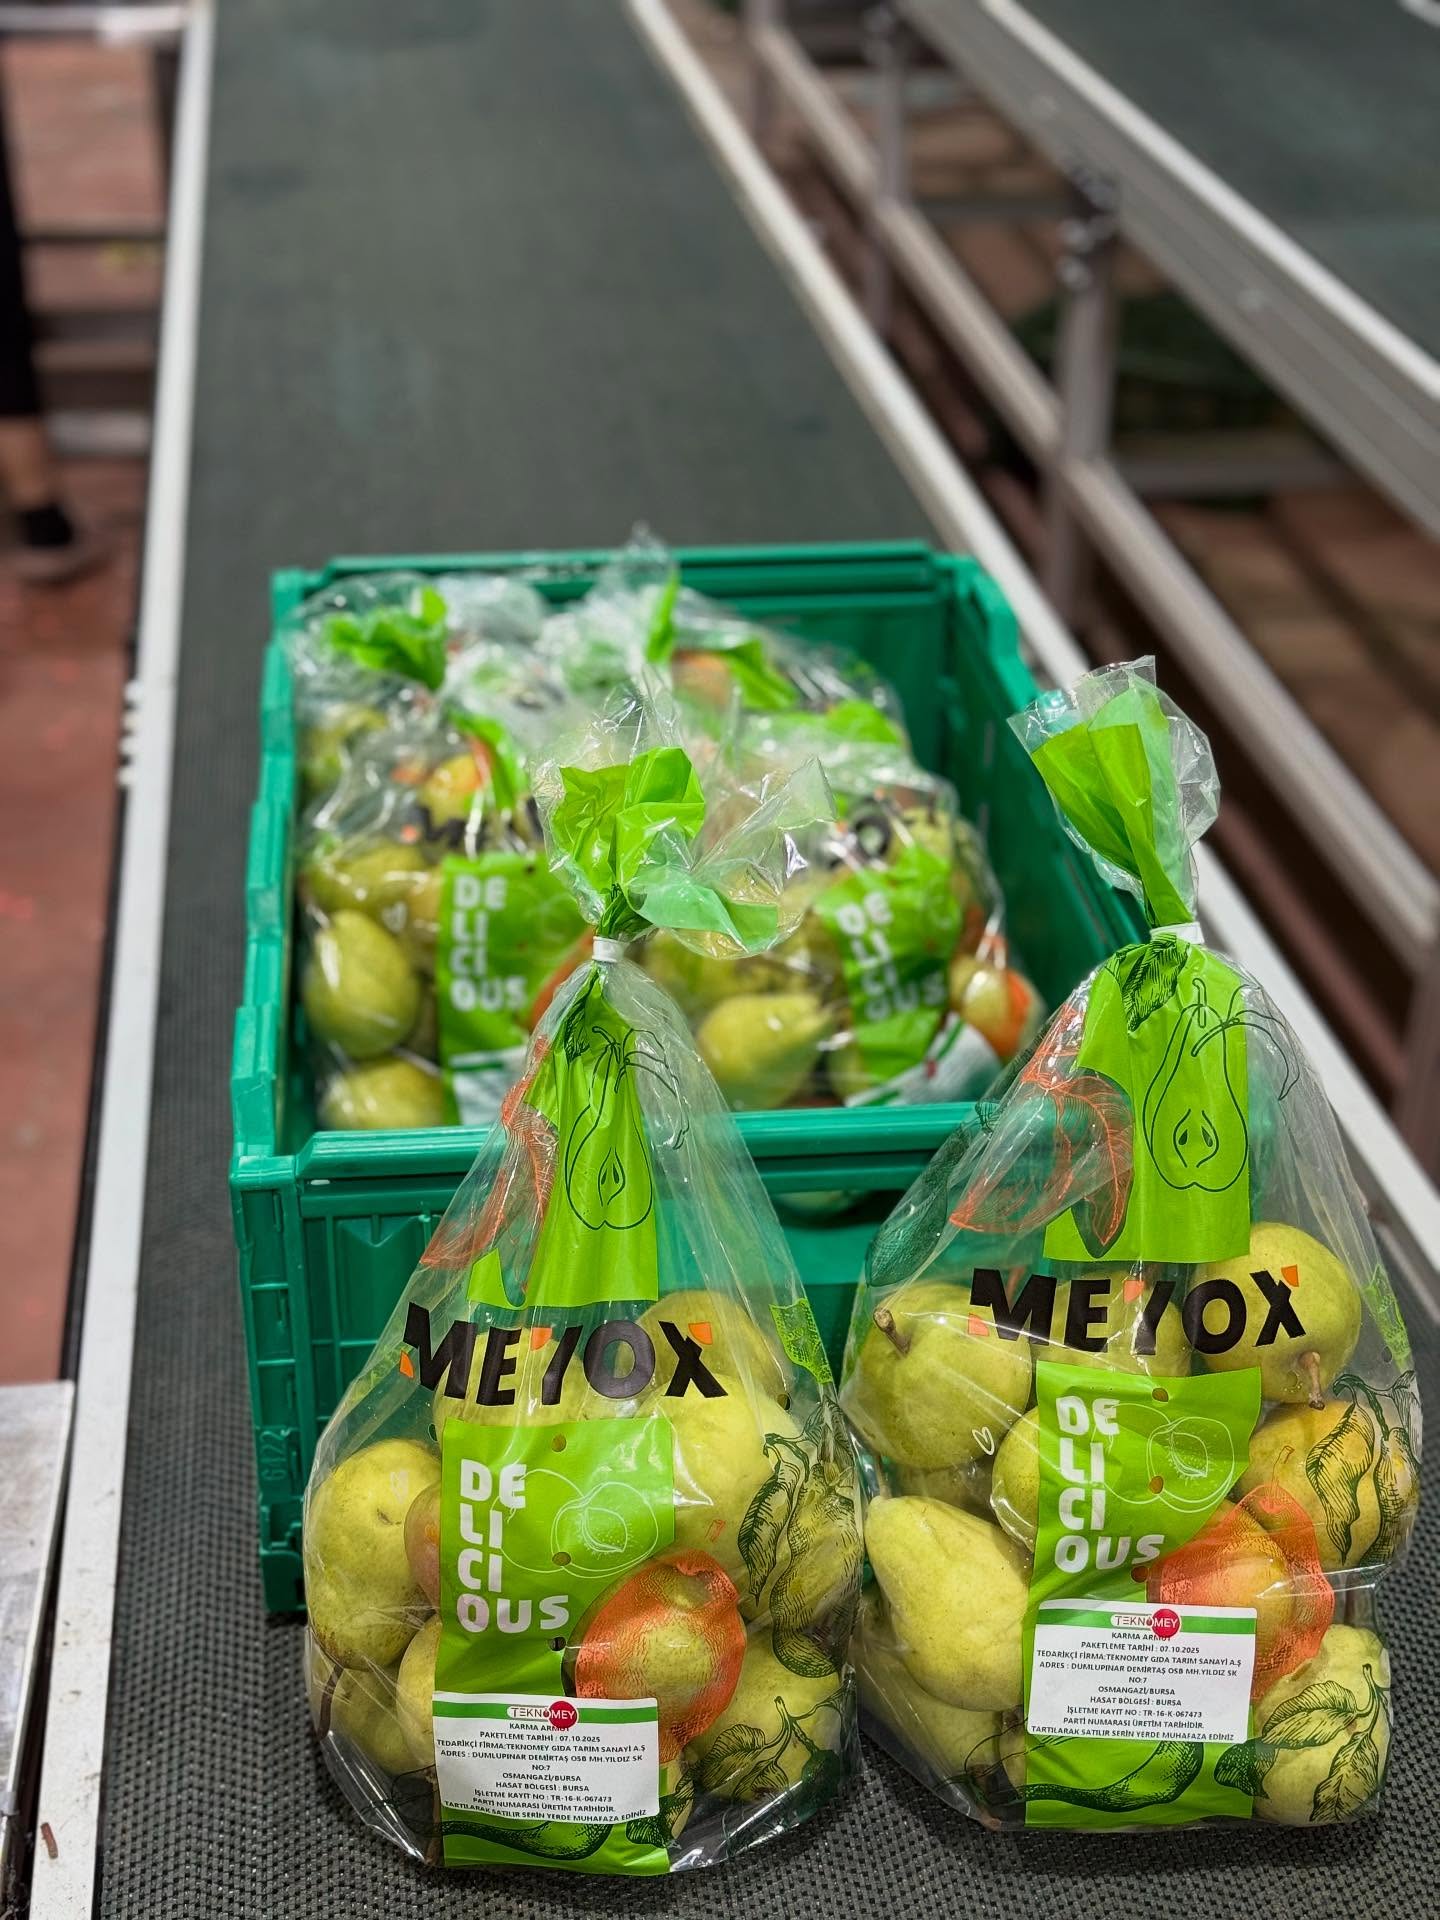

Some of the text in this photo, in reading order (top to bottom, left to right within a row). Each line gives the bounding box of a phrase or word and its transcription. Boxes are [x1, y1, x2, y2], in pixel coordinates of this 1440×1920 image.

[453, 875, 507, 910] DE
[452, 911, 488, 943] LI
[452, 946, 487, 977] CI
[451, 977, 527, 1011] OUS
[967, 1265, 1306, 1355] MEYOX
[400, 1302, 728, 1407] MEYOX
[1056, 1395, 1119, 1435] DE
[1059, 1438, 1105, 1483] LI
[460, 1459, 527, 1509] DE
[1059, 1487, 1105, 1530] CI
[460, 1504, 502, 1549] LI
[1055, 1534, 1165, 1573] OUS
[458, 1549, 502, 1592] CI
[457, 1594, 569, 1633] OUS
[1112, 1632, 1140, 1640] KARMA
[1081, 1642, 1125, 1651] PAKETLEME
[1127, 1644, 1153, 1652] TARİHİ
[1037, 1650, 1077, 1659] TEDARİKÇİ
[1199, 1657, 1227, 1665] SANAYİ
[1071, 1663, 1125, 1672] DUMLUPINAR
[1127, 1665, 1166, 1674] DEMİRTAŞ
[1098, 1686, 1175, 1695] OSMANGAZİ/BURSA
[1090, 1696, 1117, 1704] HASAT
[1118, 1697, 1150, 1705] BÖLGESİ
[1067, 1706, 1099, 1715] İŞLETME
[510, 1723, 538, 1731] KARMA
[1063, 1717, 1086, 1725] PARTİ
[1088, 1718, 1130, 1726] NUMARASI
[1132, 1718, 1161, 1727] ÜRETİM
[480, 1732, 524, 1740] PAKETLEME
[1031, 1726, 1079, 1735] TARTILARAK
[1081, 1728, 1110, 1736] SATILIR
[1112, 1729, 1134, 1737] SERİN
[1162, 1732, 1206, 1740] MUHAFAZA
[1209, 1733, 1234, 1741] EDİNİZ
[437, 1739, 477, 1748] TEDARİKÇİ
[441, 1750, 466, 1758] ADRES
[472, 1752, 526, 1760] DUMLUPINAR
[528, 1753, 568, 1763] DEMİRTAŞ
[632, 1754, 642, 1762] SK
[502, 1772, 581, 1782] OSMANGAZİ/BURSA
[444, 1801, 490, 1814] TARTILARAK
[522, 1810, 545, 1819] SERİN
[547, 1812, 571, 1821] YERDE
[573, 1814, 619, 1822] MUHAFAZA
[621, 1809, 647, 1821] EDİNİZ
[496, 1800, 539, 1809] NUMARASI
[541, 1801, 571, 1812] ÜRETİM
